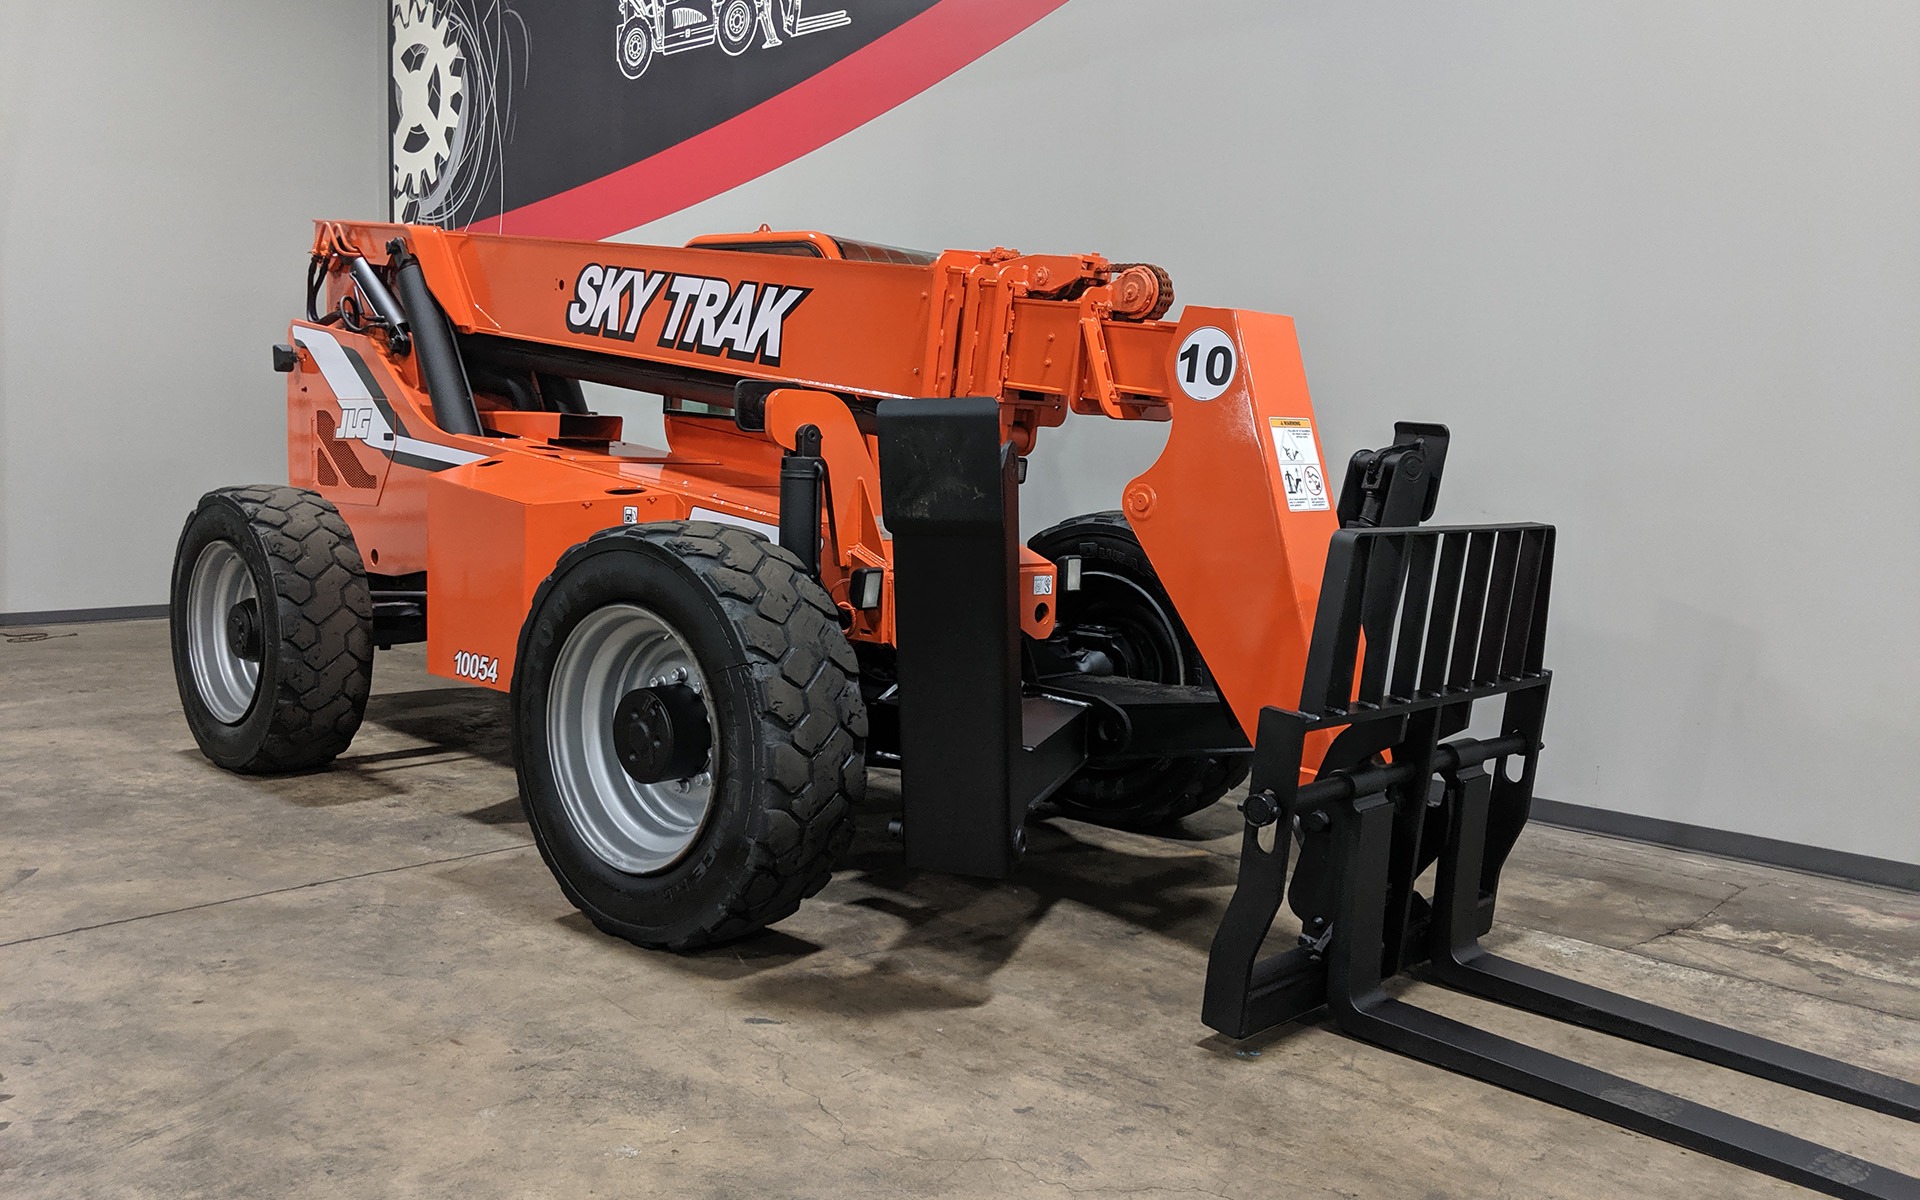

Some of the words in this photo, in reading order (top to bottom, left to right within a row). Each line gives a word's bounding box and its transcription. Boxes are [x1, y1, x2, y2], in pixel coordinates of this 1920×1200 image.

[566, 262, 670, 341] SKY
[657, 275, 813, 367] TRAK
[1179, 343, 1233, 386] 10
[335, 407, 373, 439] JLG
[454, 650, 499, 683] 10054
